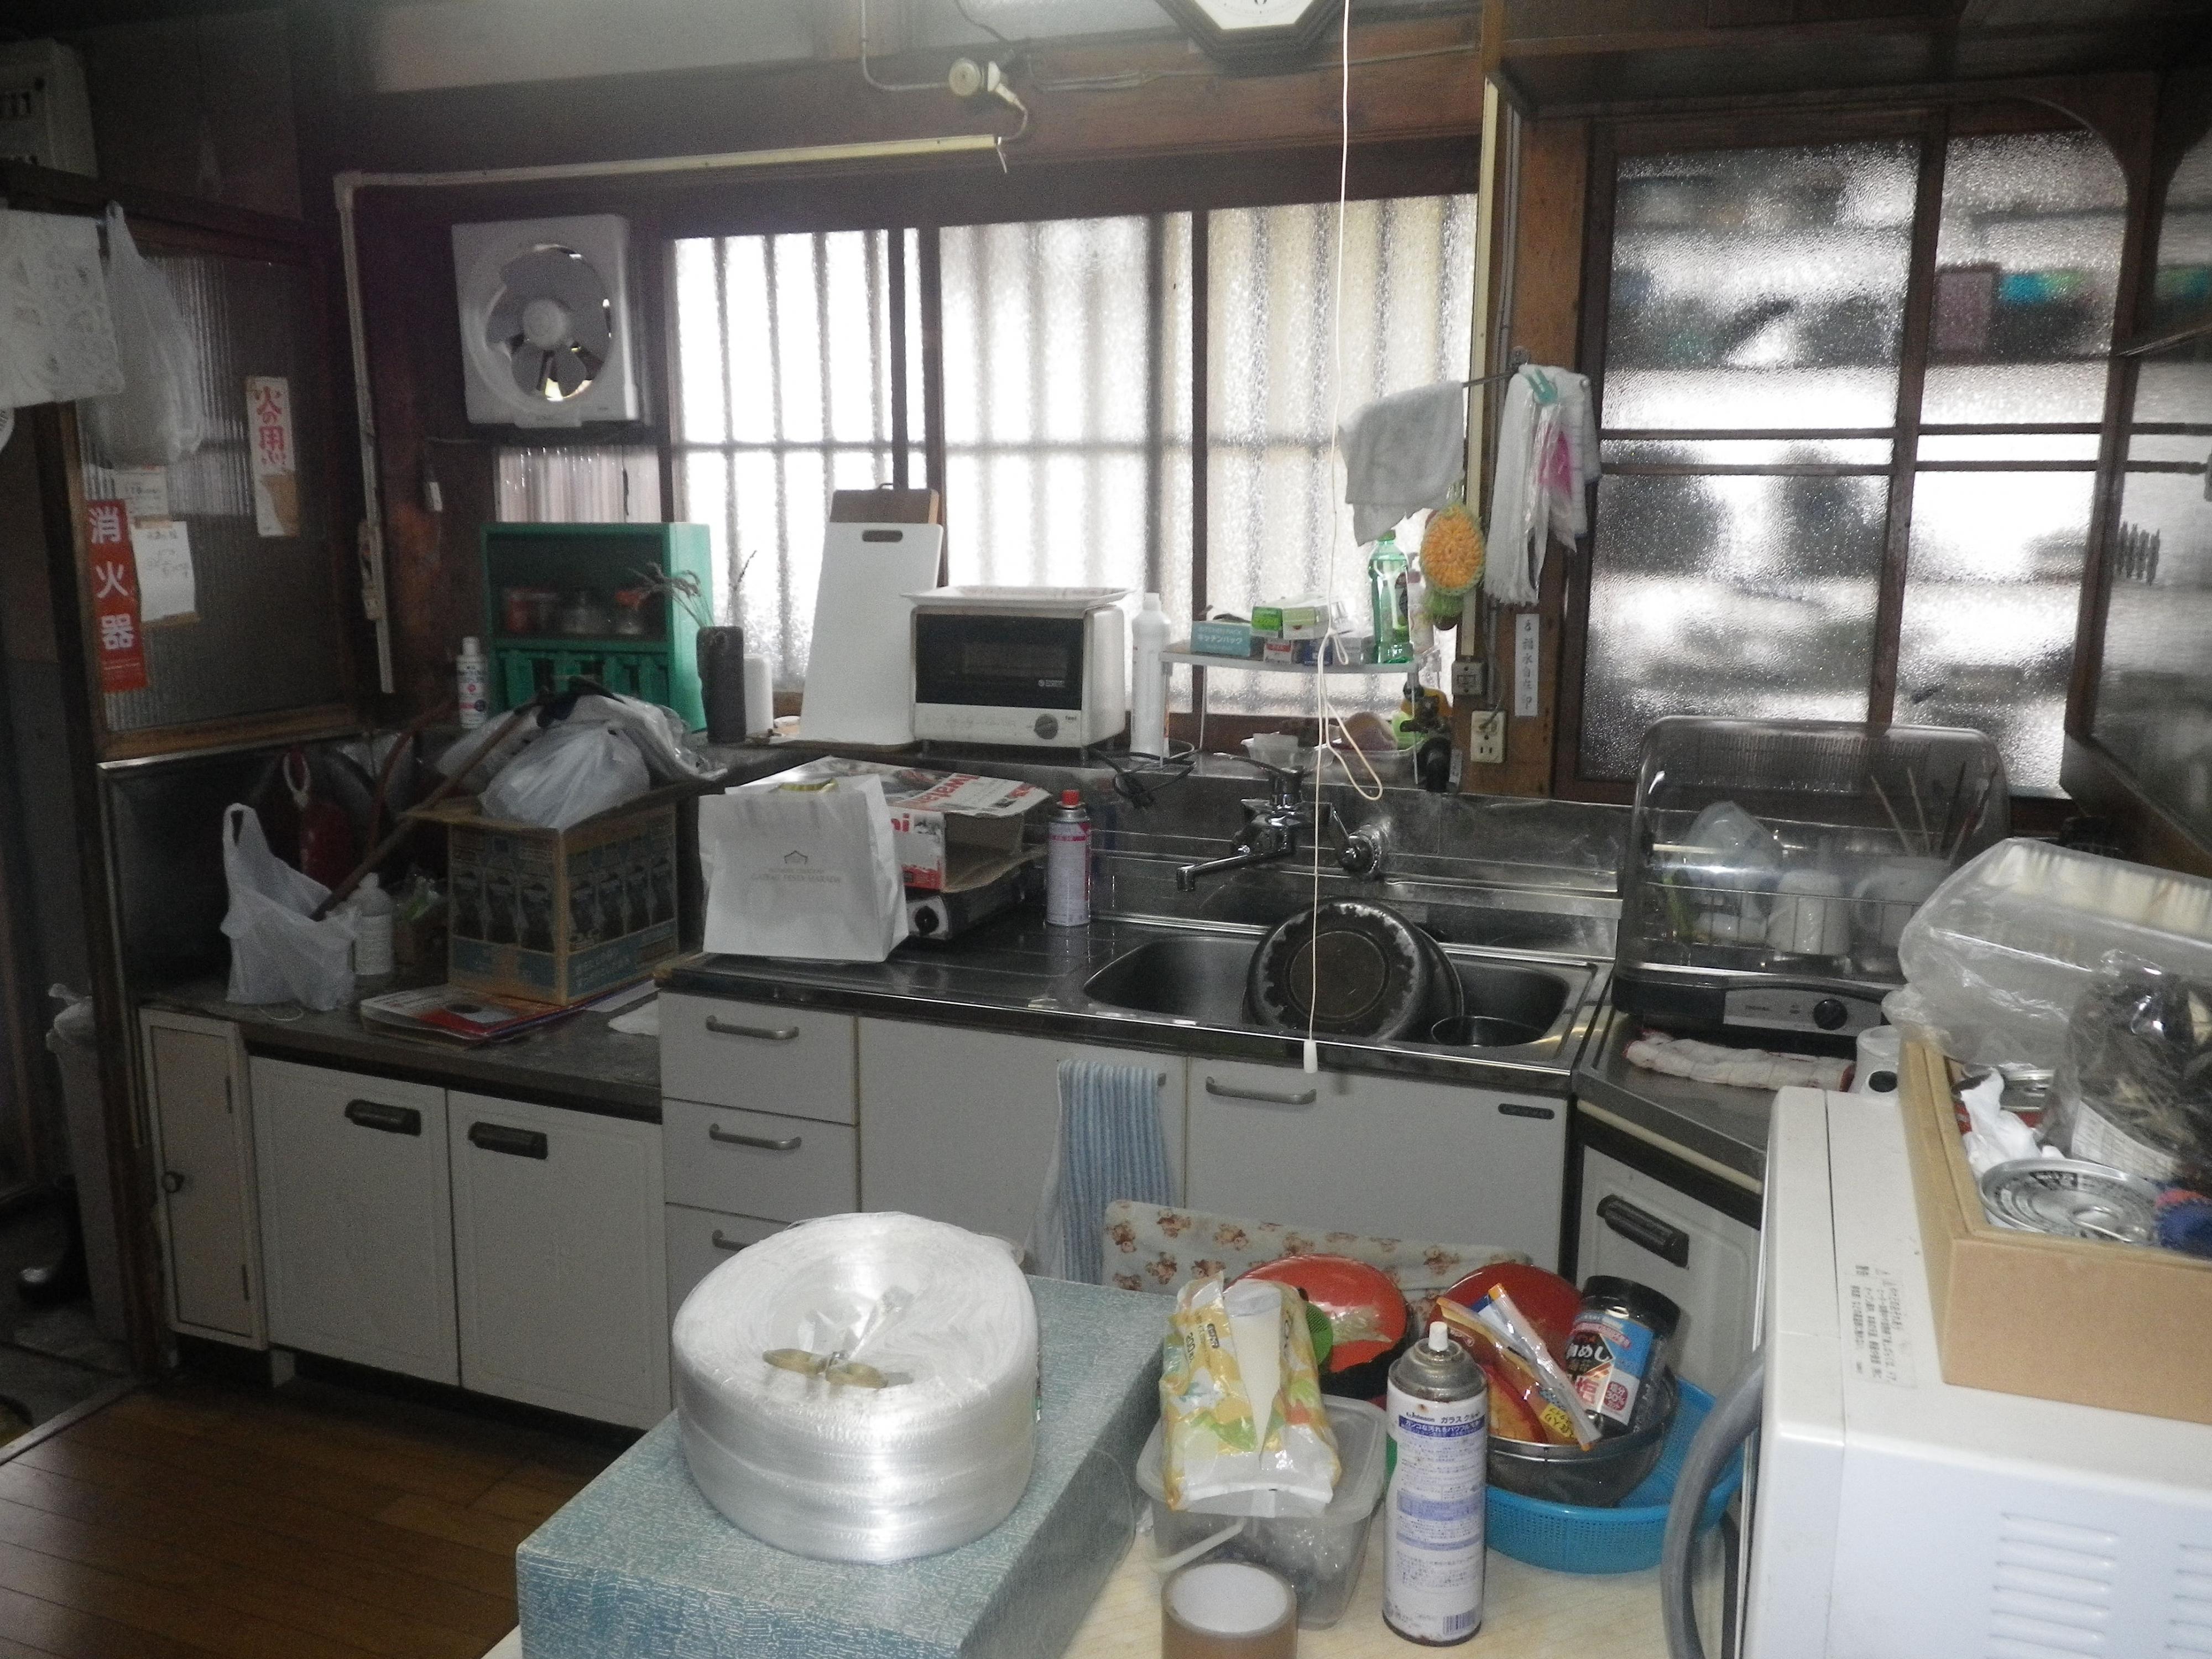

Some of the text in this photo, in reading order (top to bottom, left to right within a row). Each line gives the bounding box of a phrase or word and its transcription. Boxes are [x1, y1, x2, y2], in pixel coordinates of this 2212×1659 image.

[254, 386, 286, 466] 火の用心
[88, 505, 134, 650] 消火器
